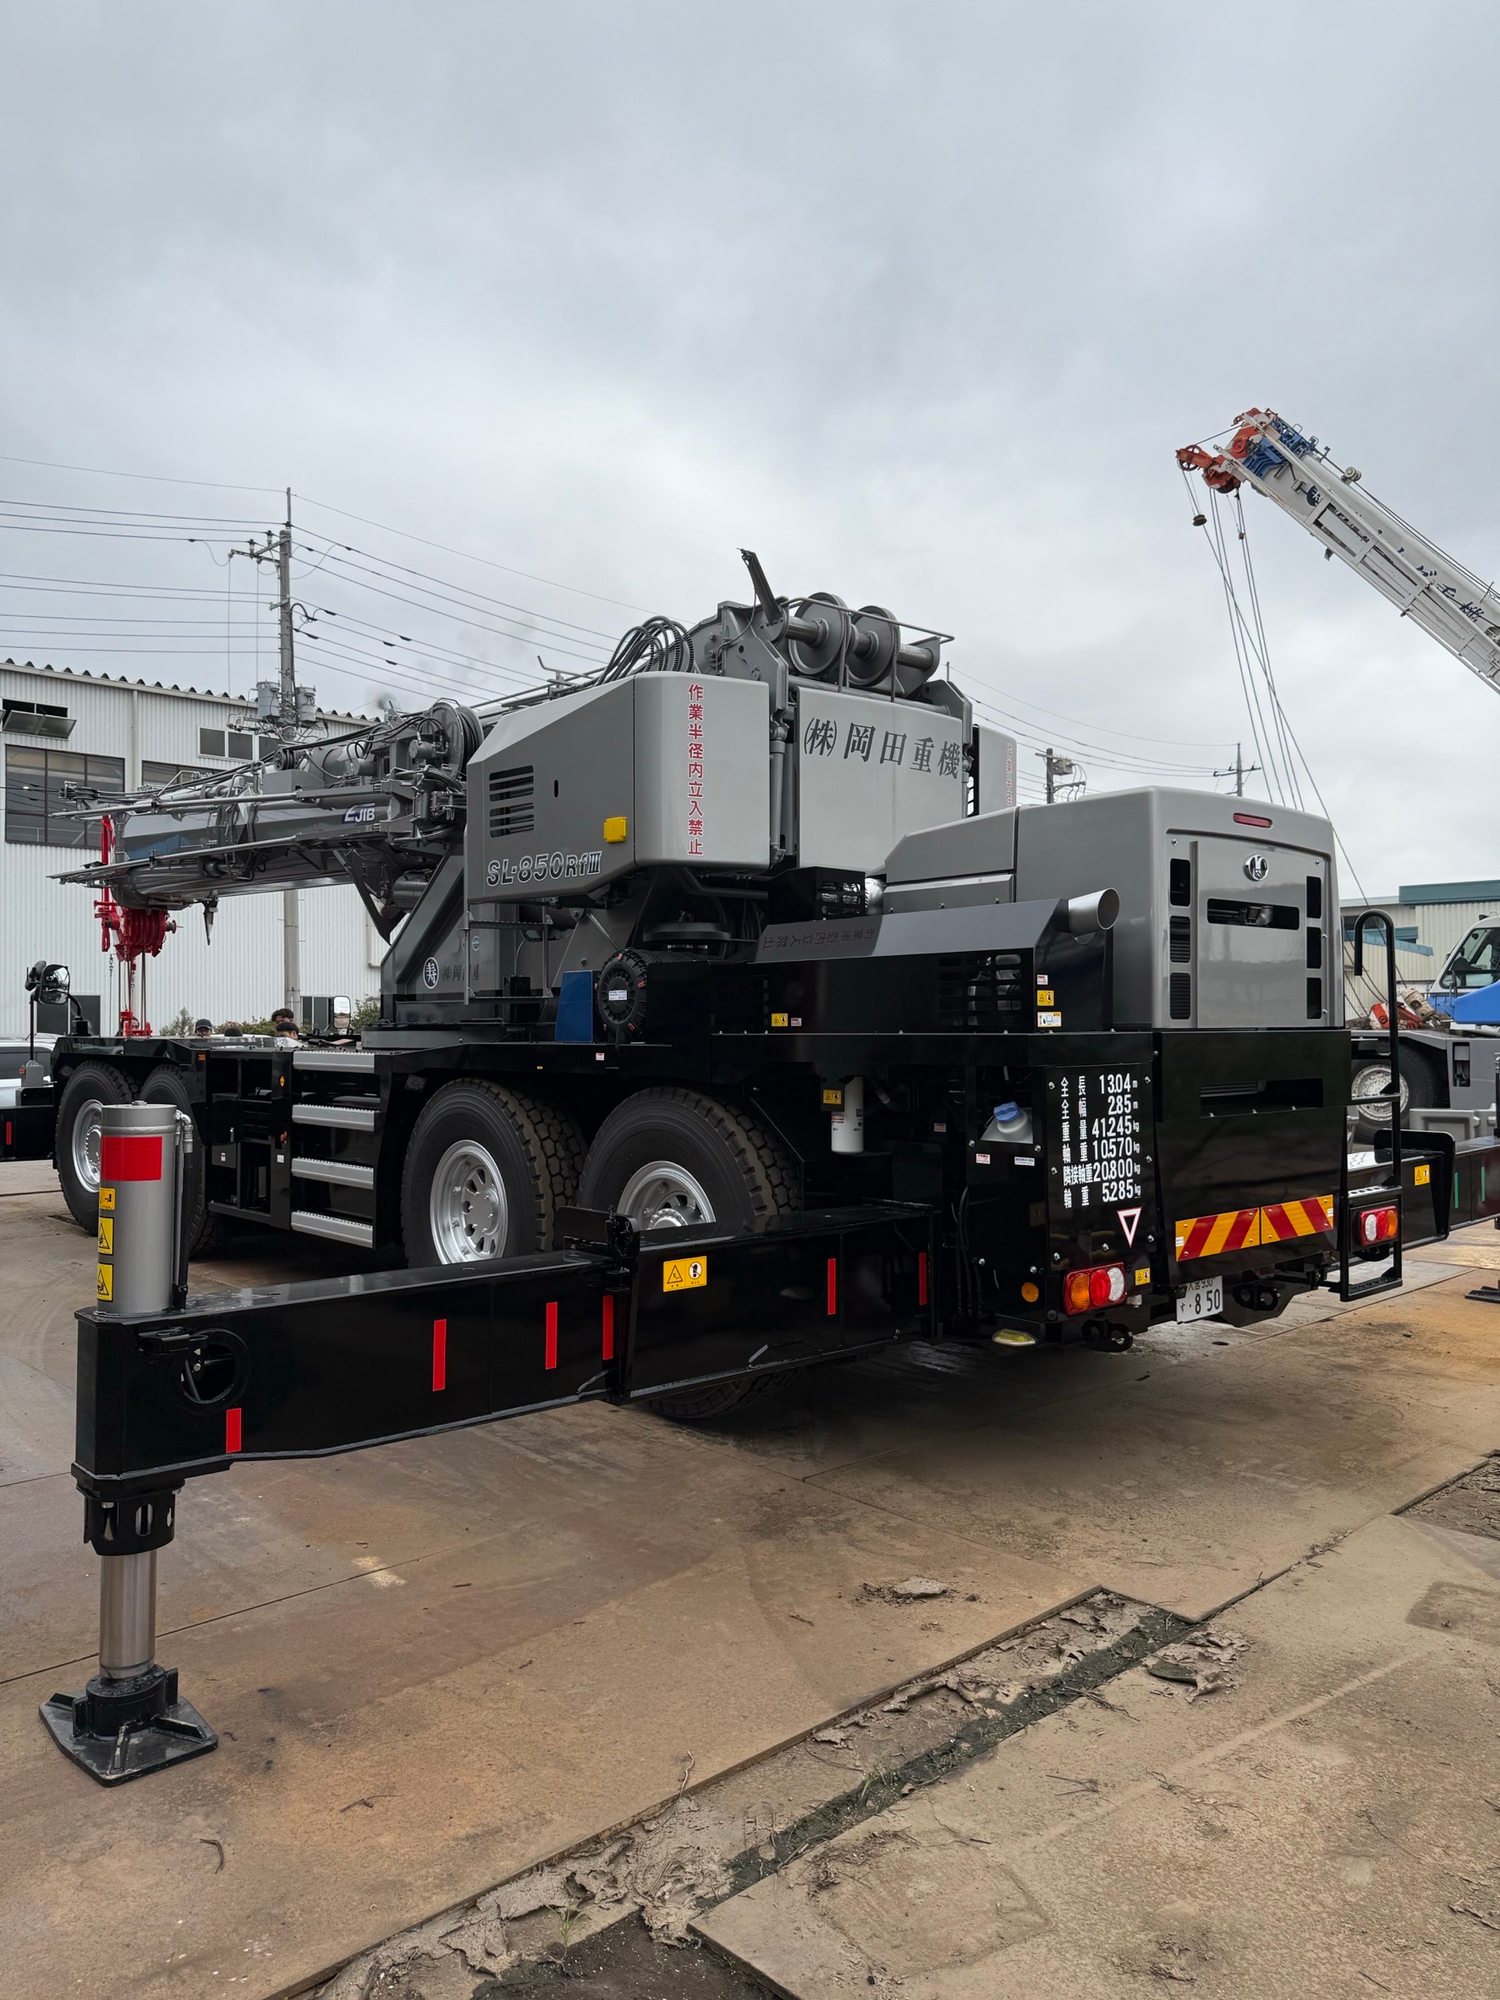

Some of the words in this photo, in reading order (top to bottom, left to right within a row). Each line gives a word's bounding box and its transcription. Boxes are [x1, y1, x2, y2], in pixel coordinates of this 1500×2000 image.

[688, 684, 704, 857] 作業半径内立入禁止
